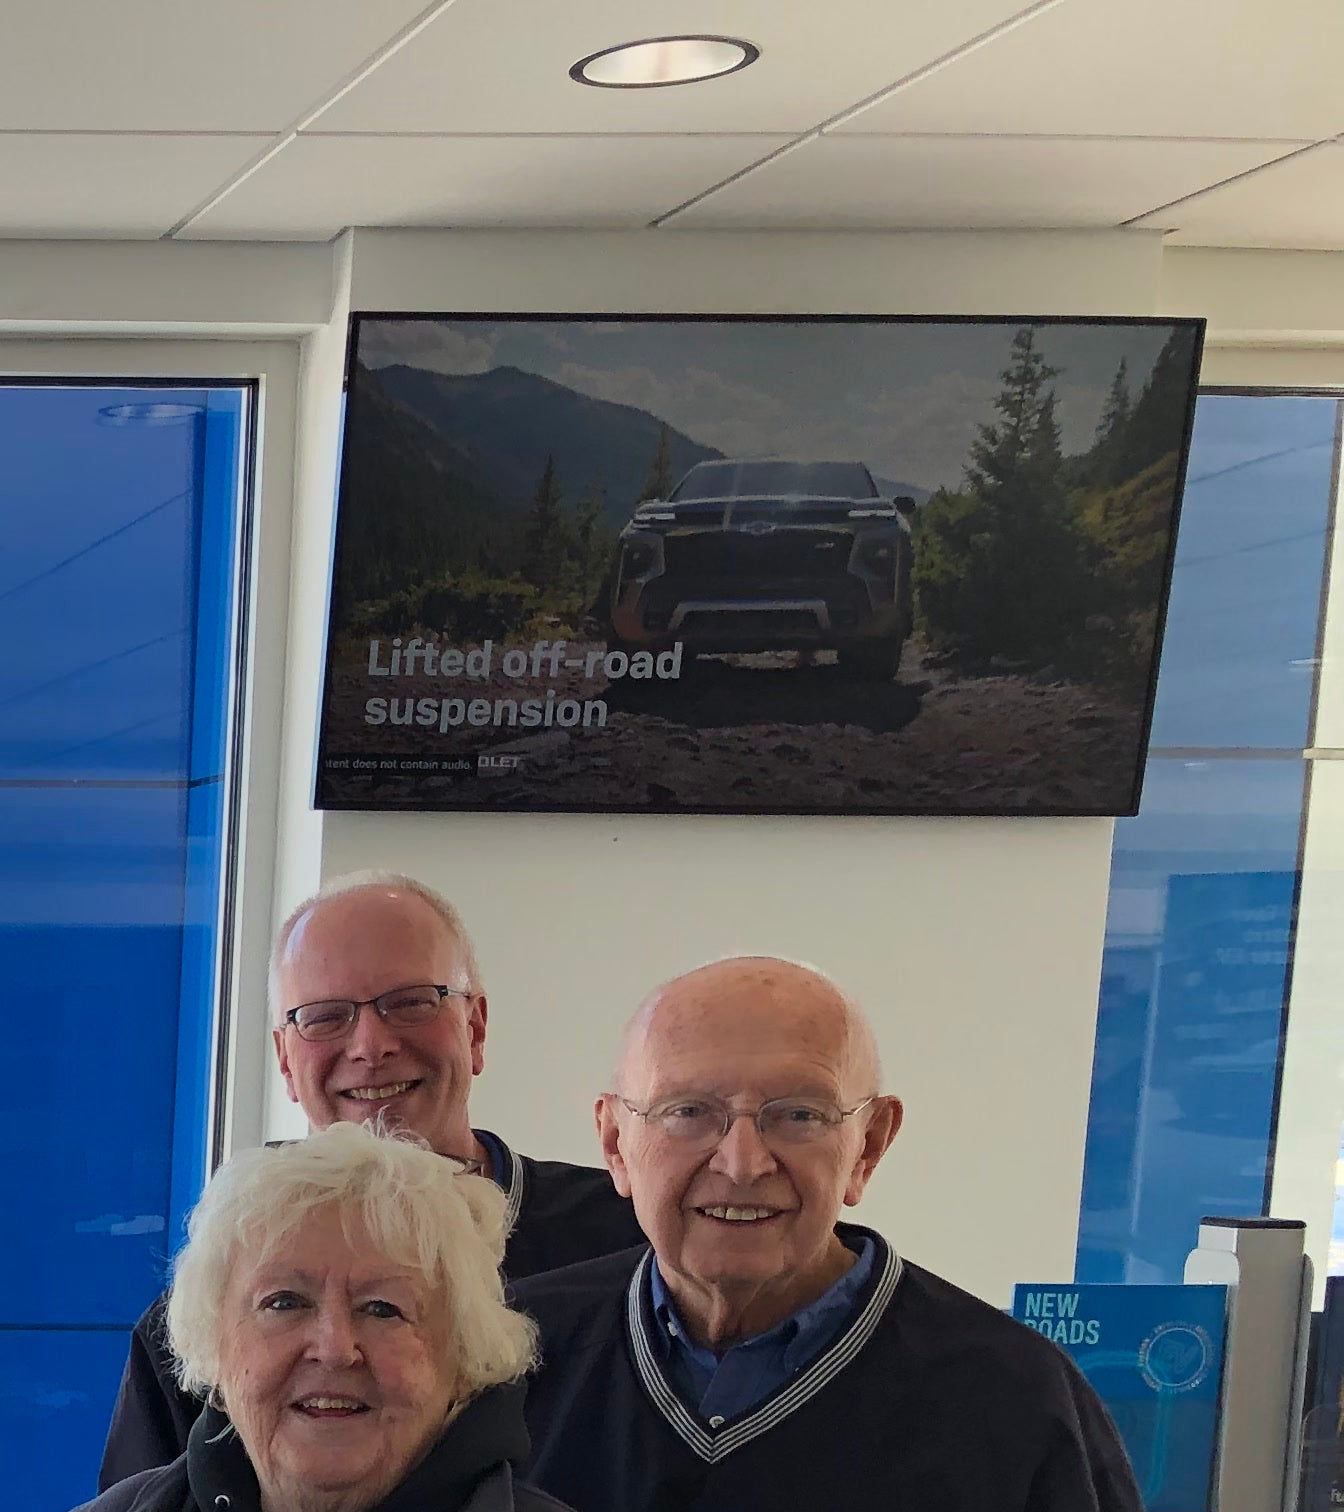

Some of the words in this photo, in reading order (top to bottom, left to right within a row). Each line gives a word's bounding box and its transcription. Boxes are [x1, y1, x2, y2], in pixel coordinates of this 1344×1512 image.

[367, 637, 493, 678] Lifted
[502, 639, 684, 680] off-road
[365, 689, 609, 733] suspension
[352, 758, 378, 769] does
[380, 758, 397, 769] not
[400, 758, 439, 769] contain
[1025, 1292, 1079, 1319] NEW
